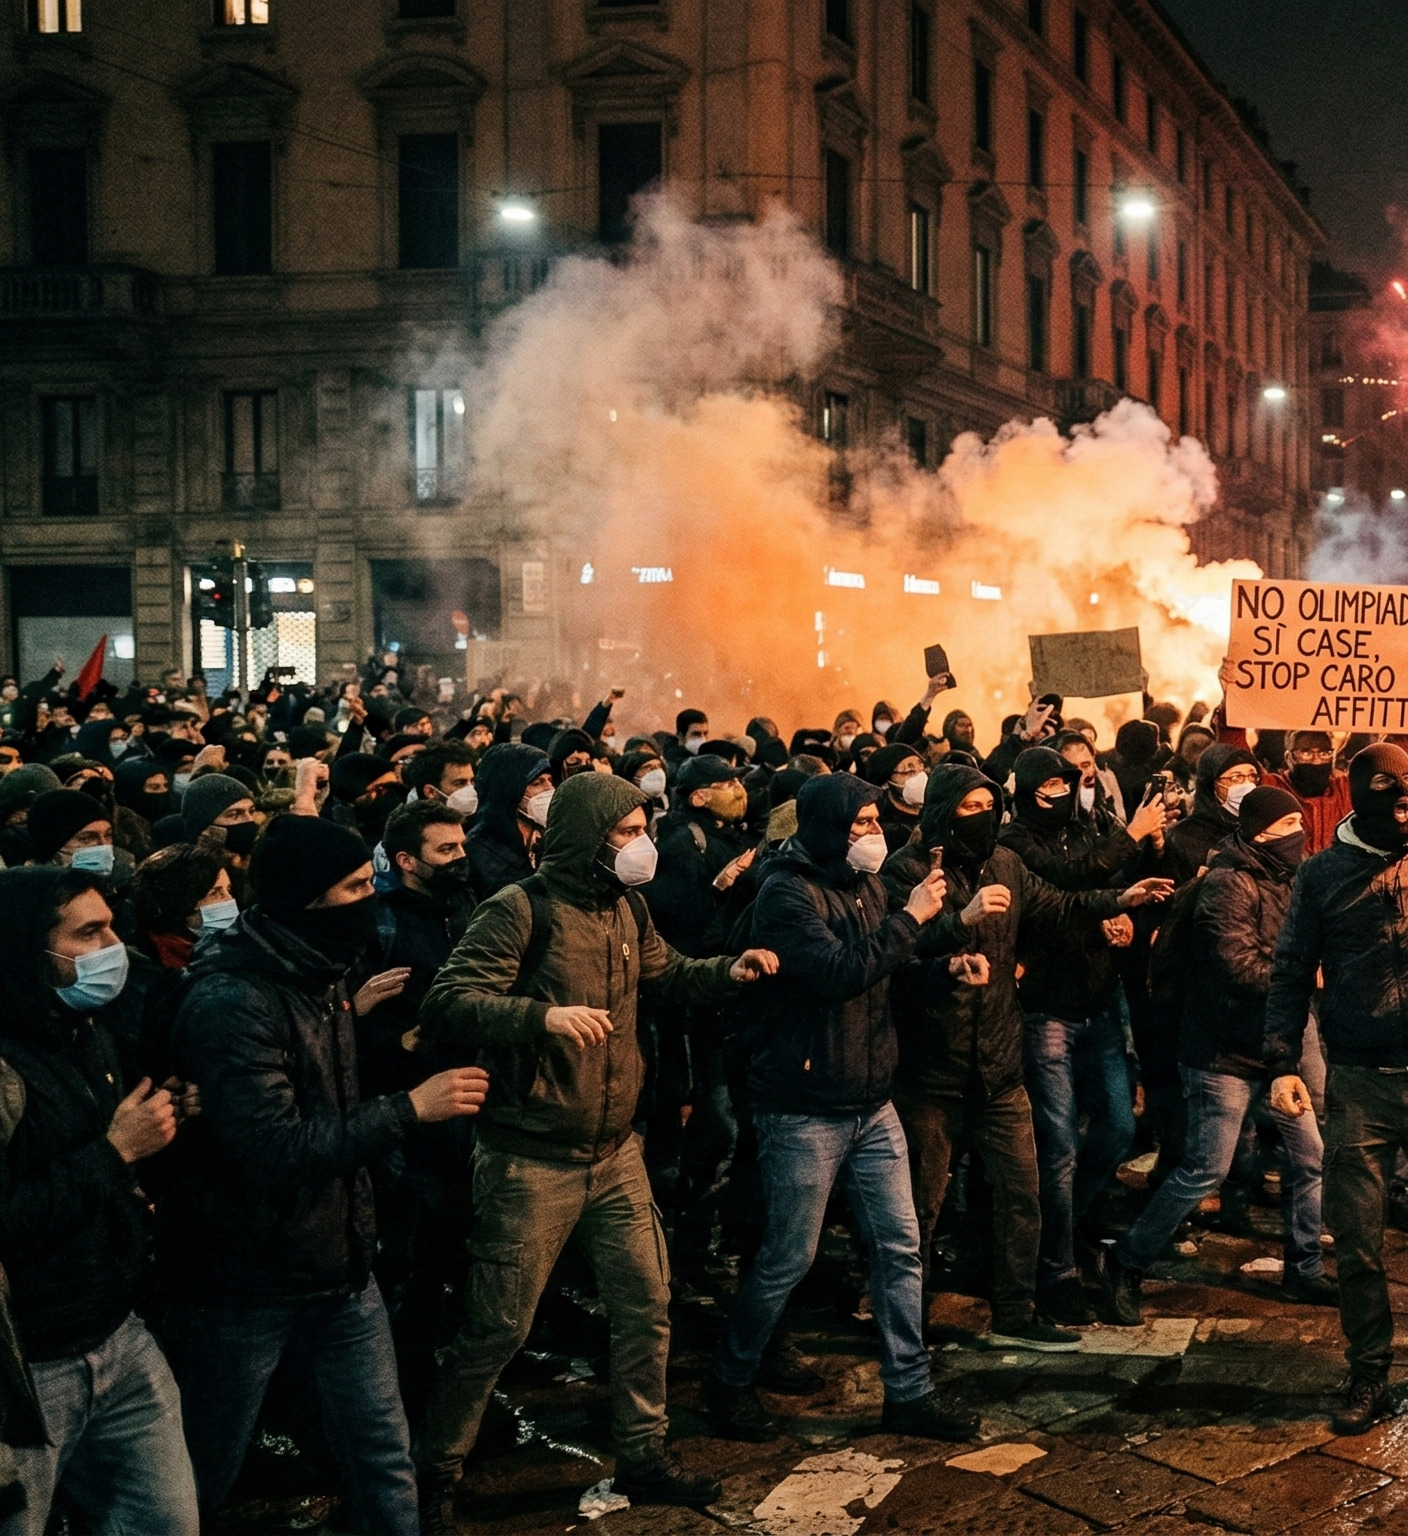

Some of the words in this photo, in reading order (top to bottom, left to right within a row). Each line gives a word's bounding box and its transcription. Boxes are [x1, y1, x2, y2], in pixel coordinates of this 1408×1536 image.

[1237, 585, 1285, 620] NO
[1253, 623, 1287, 656] SÌ
[1297, 628, 1380, 663] CASE,
[1235, 660, 1310, 690] STOP
[1321, 664, 1395, 693] CARO
